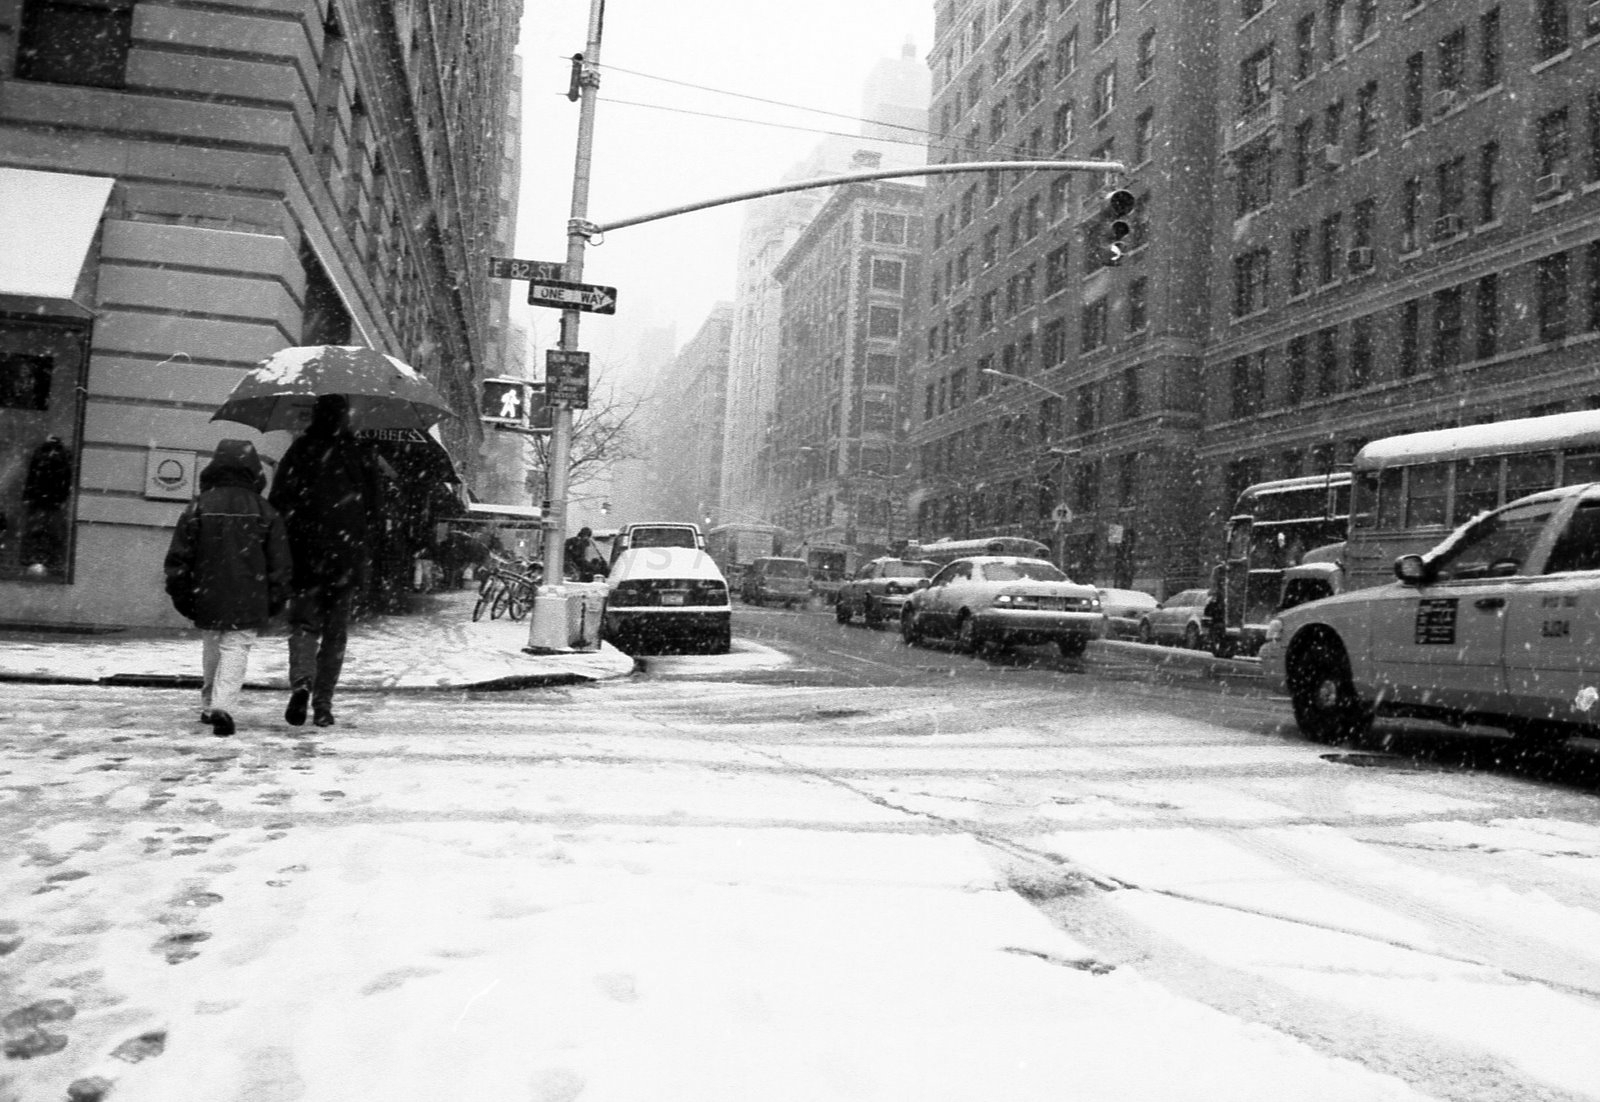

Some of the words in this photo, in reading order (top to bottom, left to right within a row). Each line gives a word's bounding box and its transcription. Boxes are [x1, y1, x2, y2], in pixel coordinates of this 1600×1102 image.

[493, 261, 502, 277] E
[510, 263, 530, 279] 82
[537, 265, 555, 280] ST
[541, 288, 565, 300] ONE
[580, 292, 605, 305] WAY
